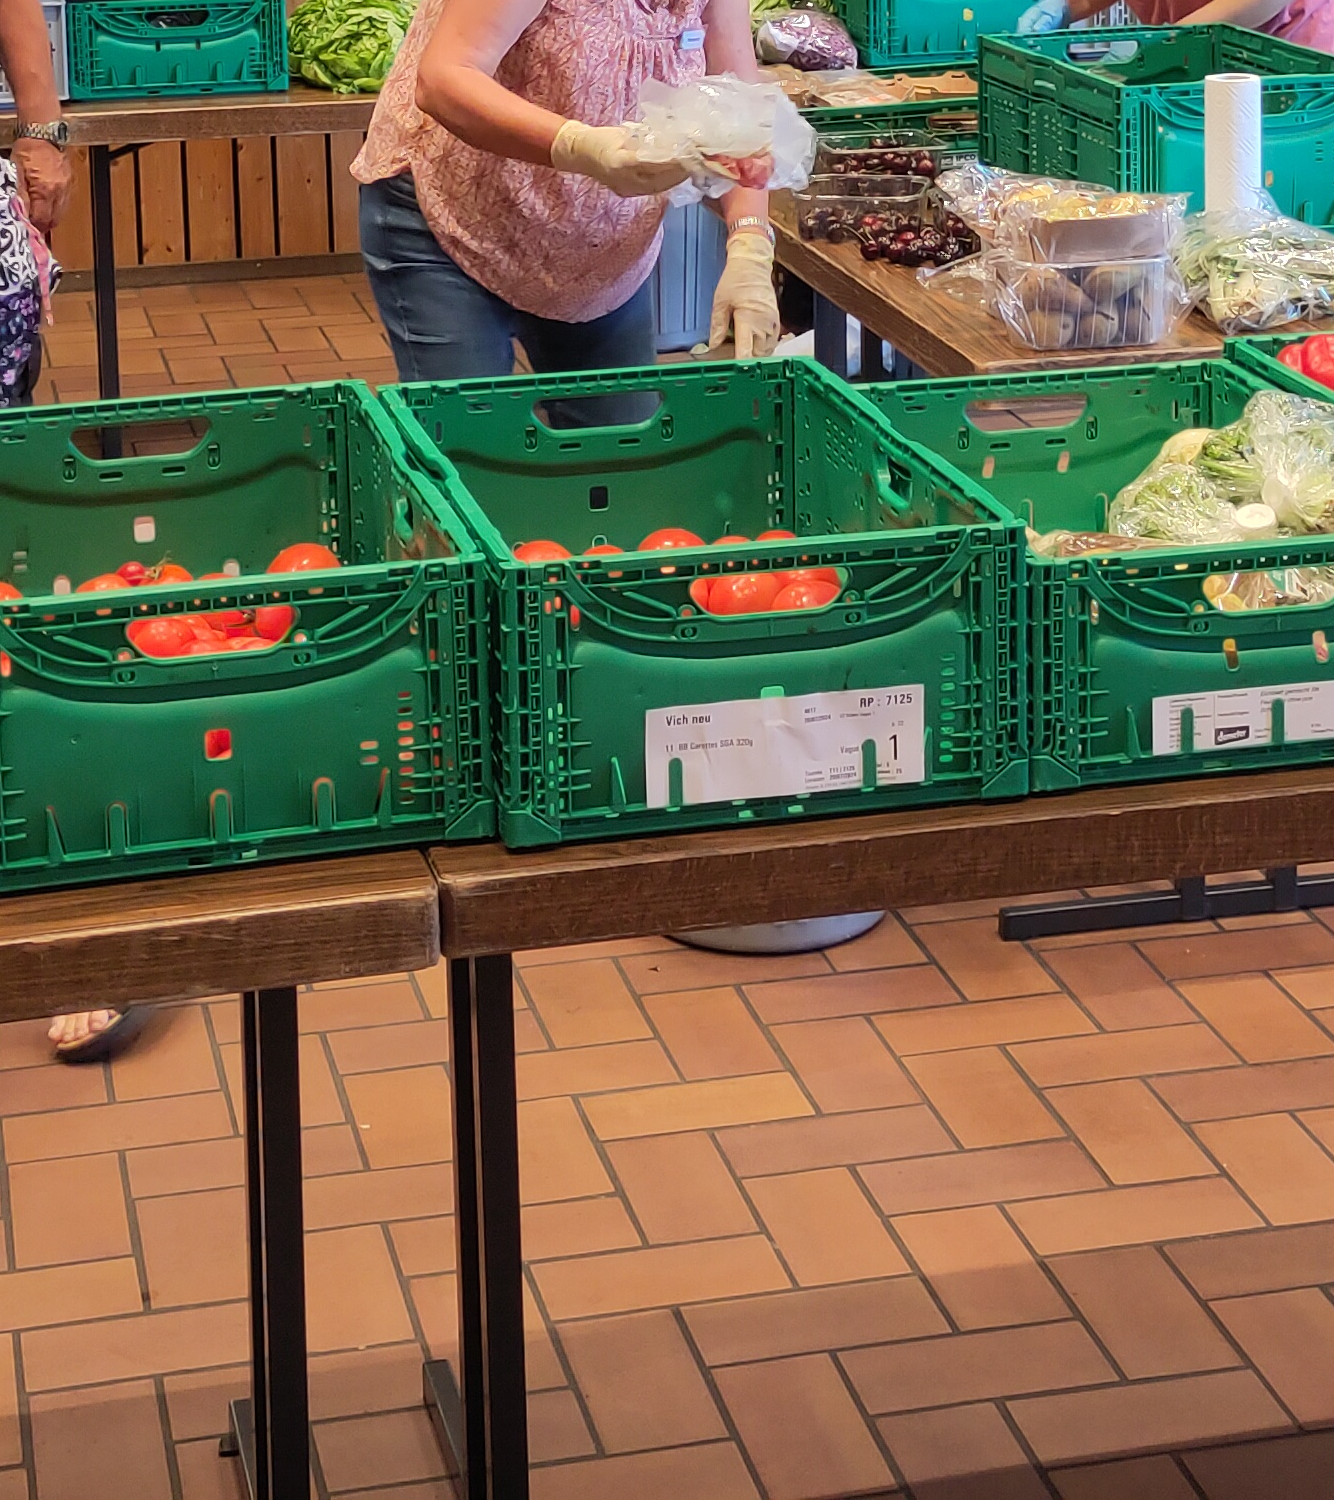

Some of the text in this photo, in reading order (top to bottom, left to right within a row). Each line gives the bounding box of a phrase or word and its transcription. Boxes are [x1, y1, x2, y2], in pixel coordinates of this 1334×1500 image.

[886, 693, 913, 706] 7125
[665, 714, 689, 727] Vich
[888, 734, 898, 761] 1
